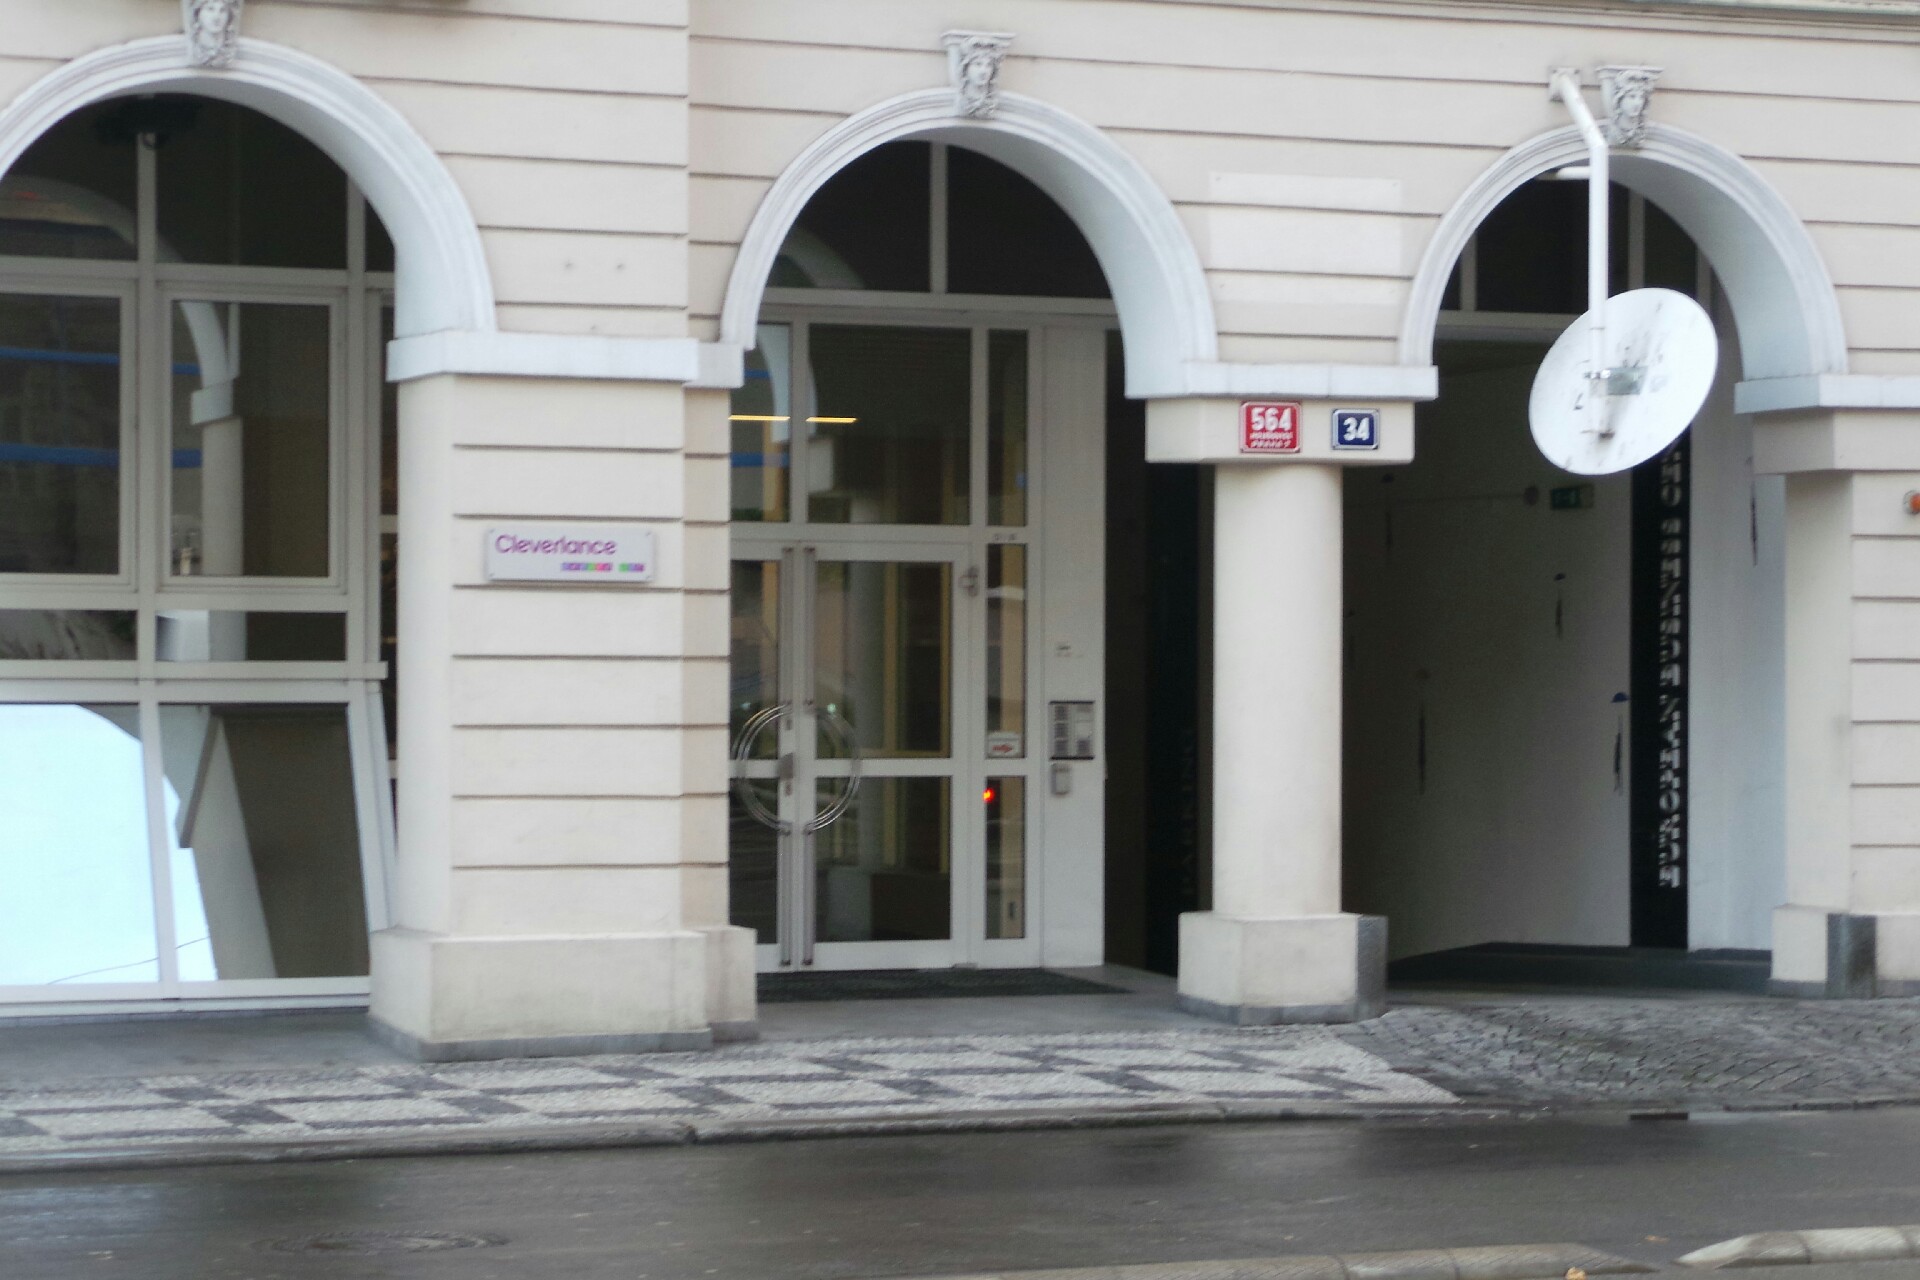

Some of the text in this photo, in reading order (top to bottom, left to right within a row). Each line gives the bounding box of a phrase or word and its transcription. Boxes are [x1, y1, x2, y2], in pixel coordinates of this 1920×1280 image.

[1251, 407, 1292, 431] 564
[1343, 417, 1370, 441] 34
[495, 533, 617, 555] Cleverlance
[1659, 518, 1681, 687] BUSINESS
[1659, 694, 1681, 888] EUROPEAN
